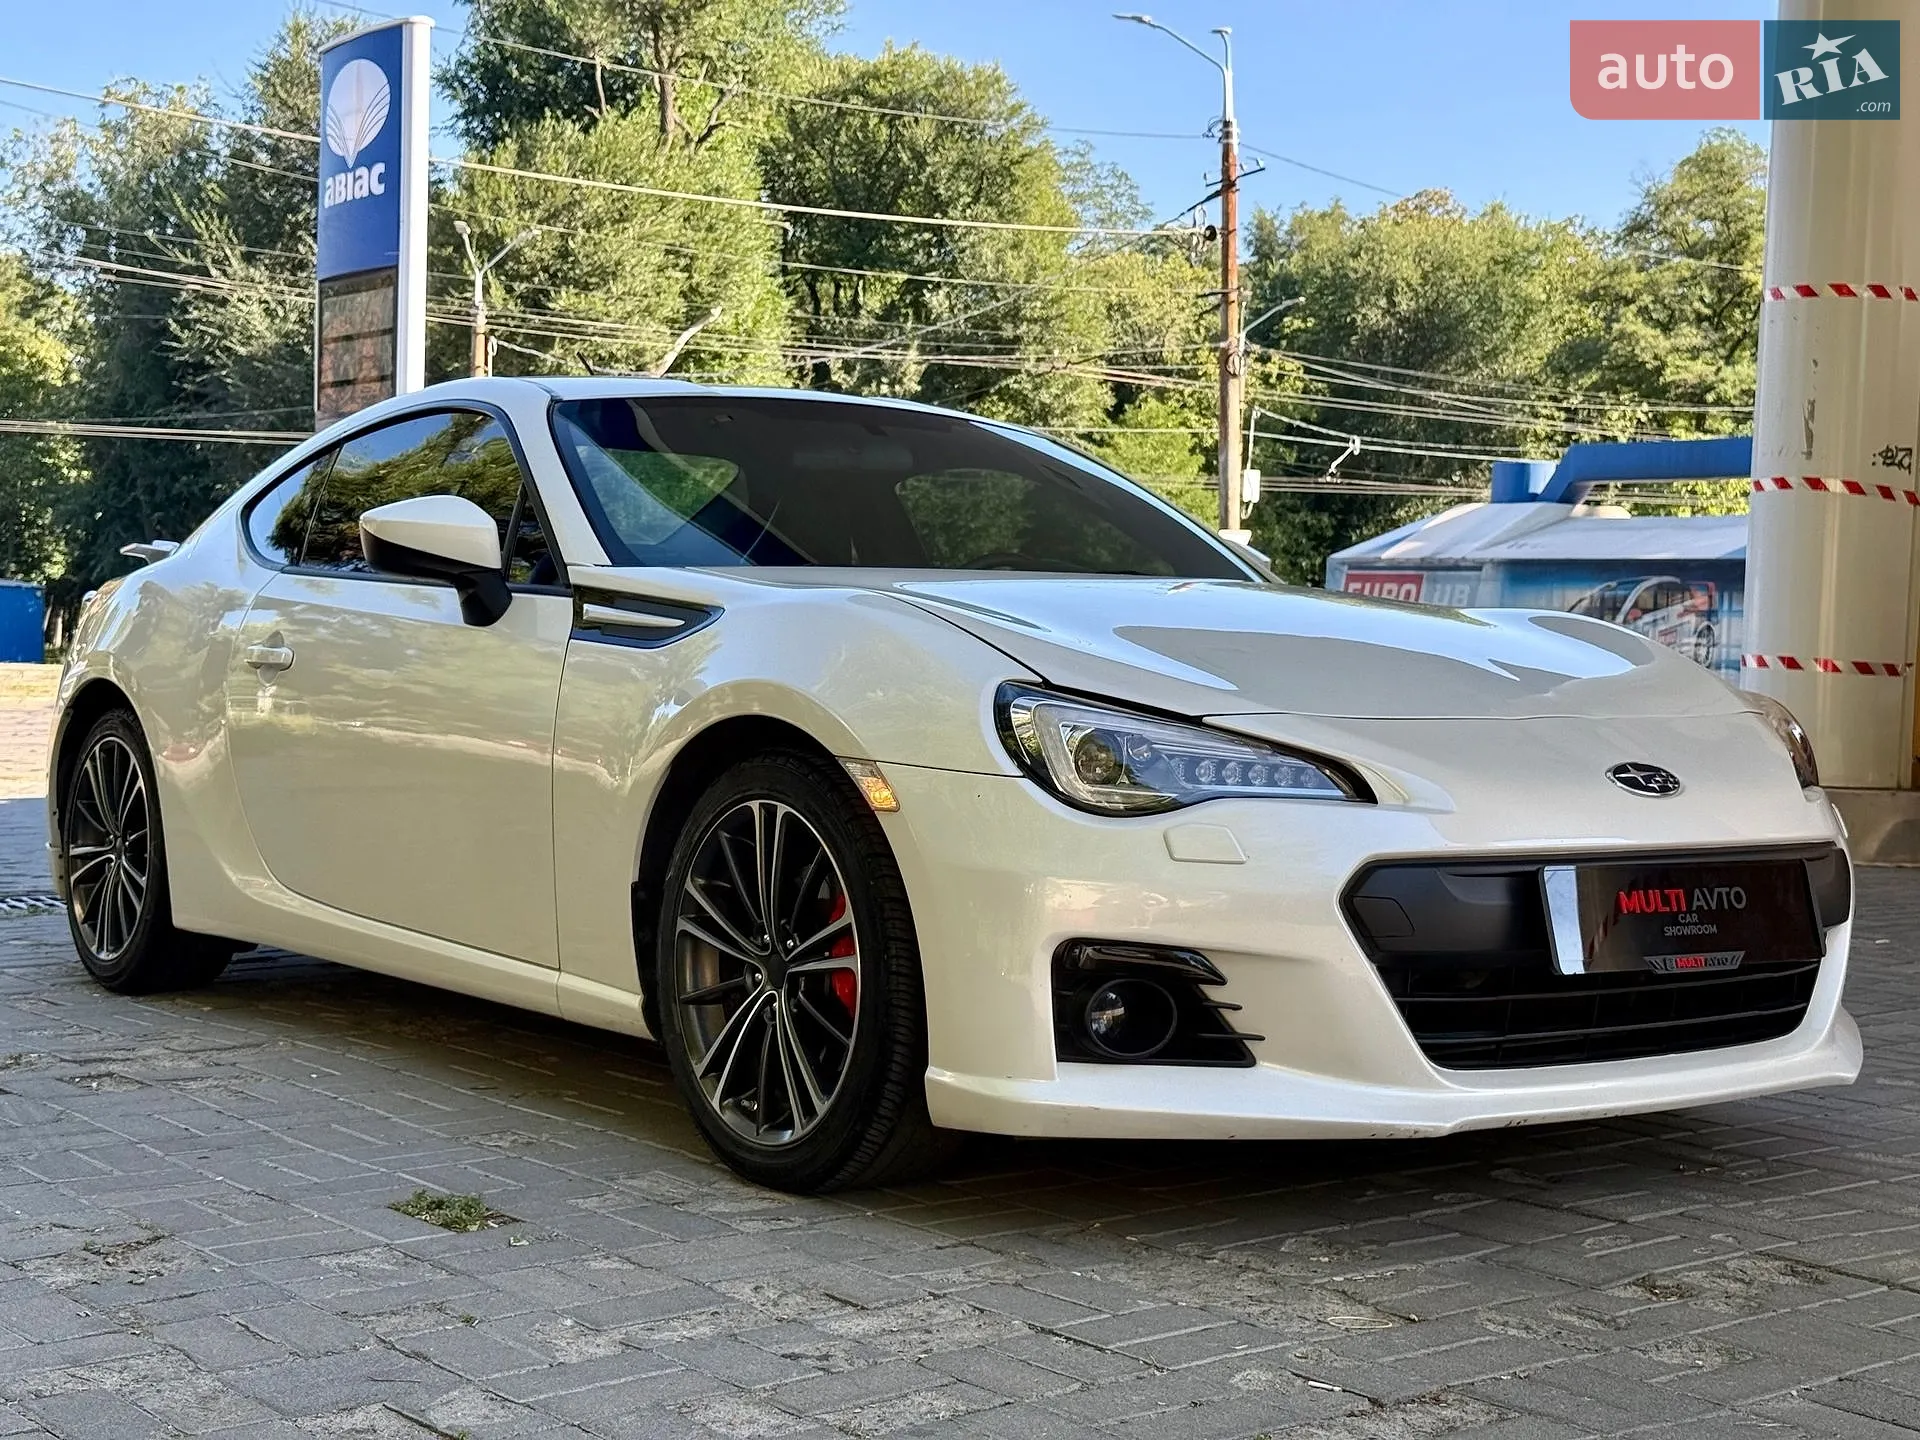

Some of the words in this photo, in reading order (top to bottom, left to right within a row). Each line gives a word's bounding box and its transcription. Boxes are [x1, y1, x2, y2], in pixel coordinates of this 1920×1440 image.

[1618, 888, 1687, 913] MULTI
[1692, 886, 1747, 911] AVTO
[1678, 913, 1699, 923] CAR
[1664, 924, 1717, 936] SHOWROOM
